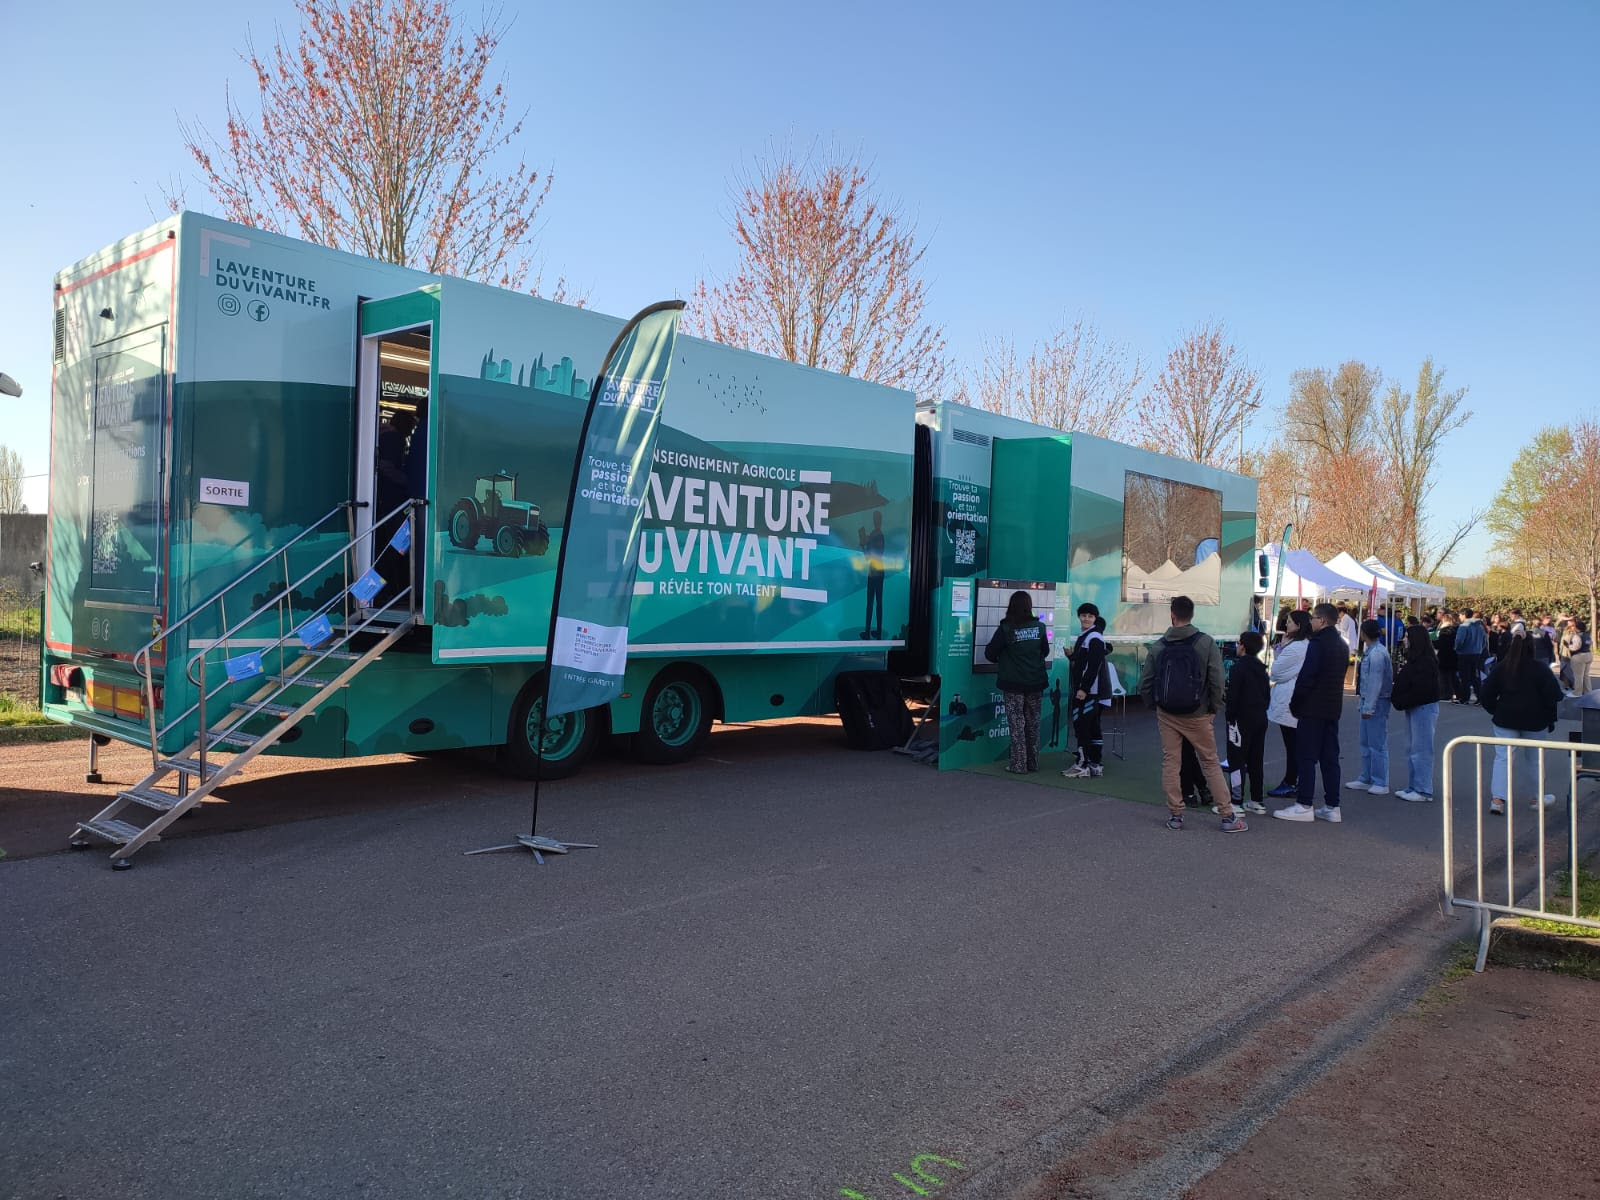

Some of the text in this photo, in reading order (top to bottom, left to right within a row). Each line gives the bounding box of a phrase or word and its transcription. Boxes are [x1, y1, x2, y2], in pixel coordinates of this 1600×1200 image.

[216, 258, 316, 292] LAVENTURE
[216, 273, 330, 310] DUVIVANT.FR
[588, 455, 632, 473] Trouve ta
[653, 449, 796, 482] NSEIGNEMENT AGRICOLE
[206, 486, 243, 498] SORTIE
[598, 482, 609, 491] et
[949, 480, 978, 494] Trouve ta
[581, 488, 640, 507] orientatio
[643, 471, 831, 535] VENTURE
[952, 491, 980, 504] passion
[947, 508, 988, 523] orientation
[958, 503, 977, 512] et ton
[659, 578, 777, 599] RÉVÈLE TON TALENT
